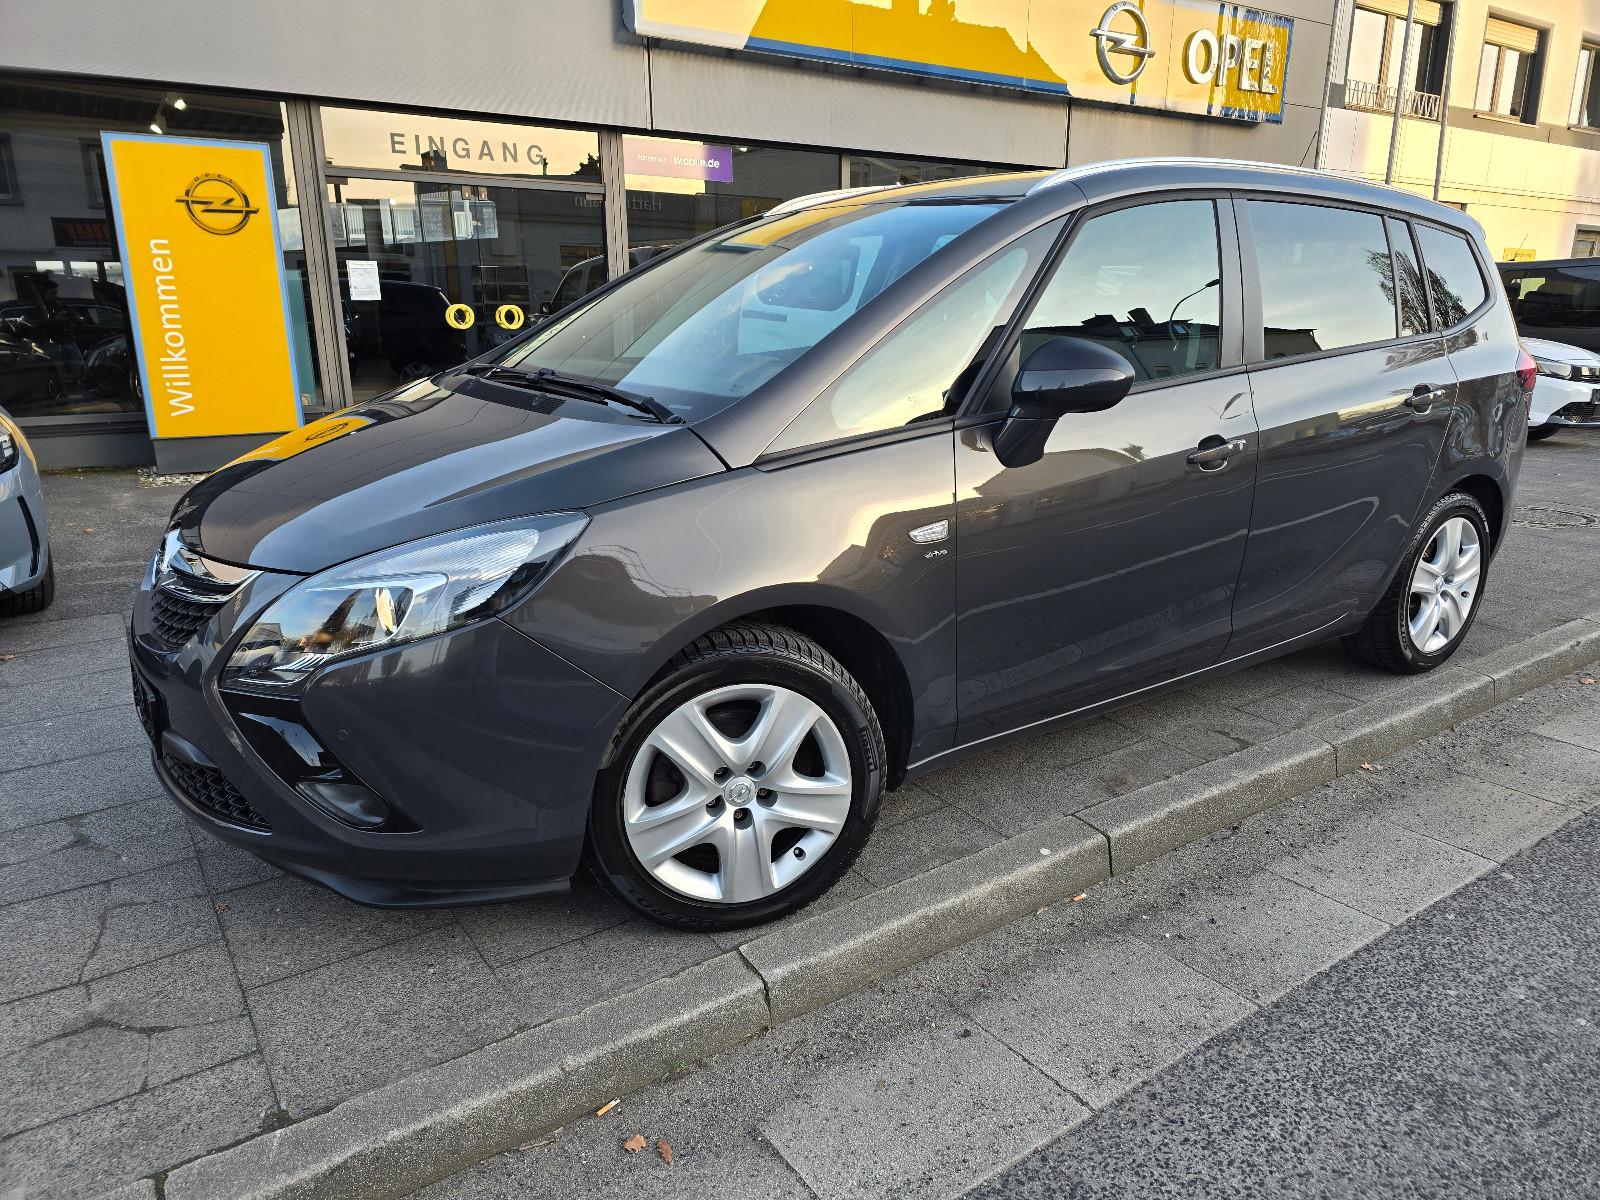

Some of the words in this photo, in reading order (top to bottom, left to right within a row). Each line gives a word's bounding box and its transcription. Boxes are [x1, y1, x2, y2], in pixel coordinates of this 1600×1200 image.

[1184, 28, 1279, 94] OPEL
[389, 132, 545, 166] EINGANG
[673, 156, 720, 168] mobile.de
[149, 239, 195, 417] Willkommen
